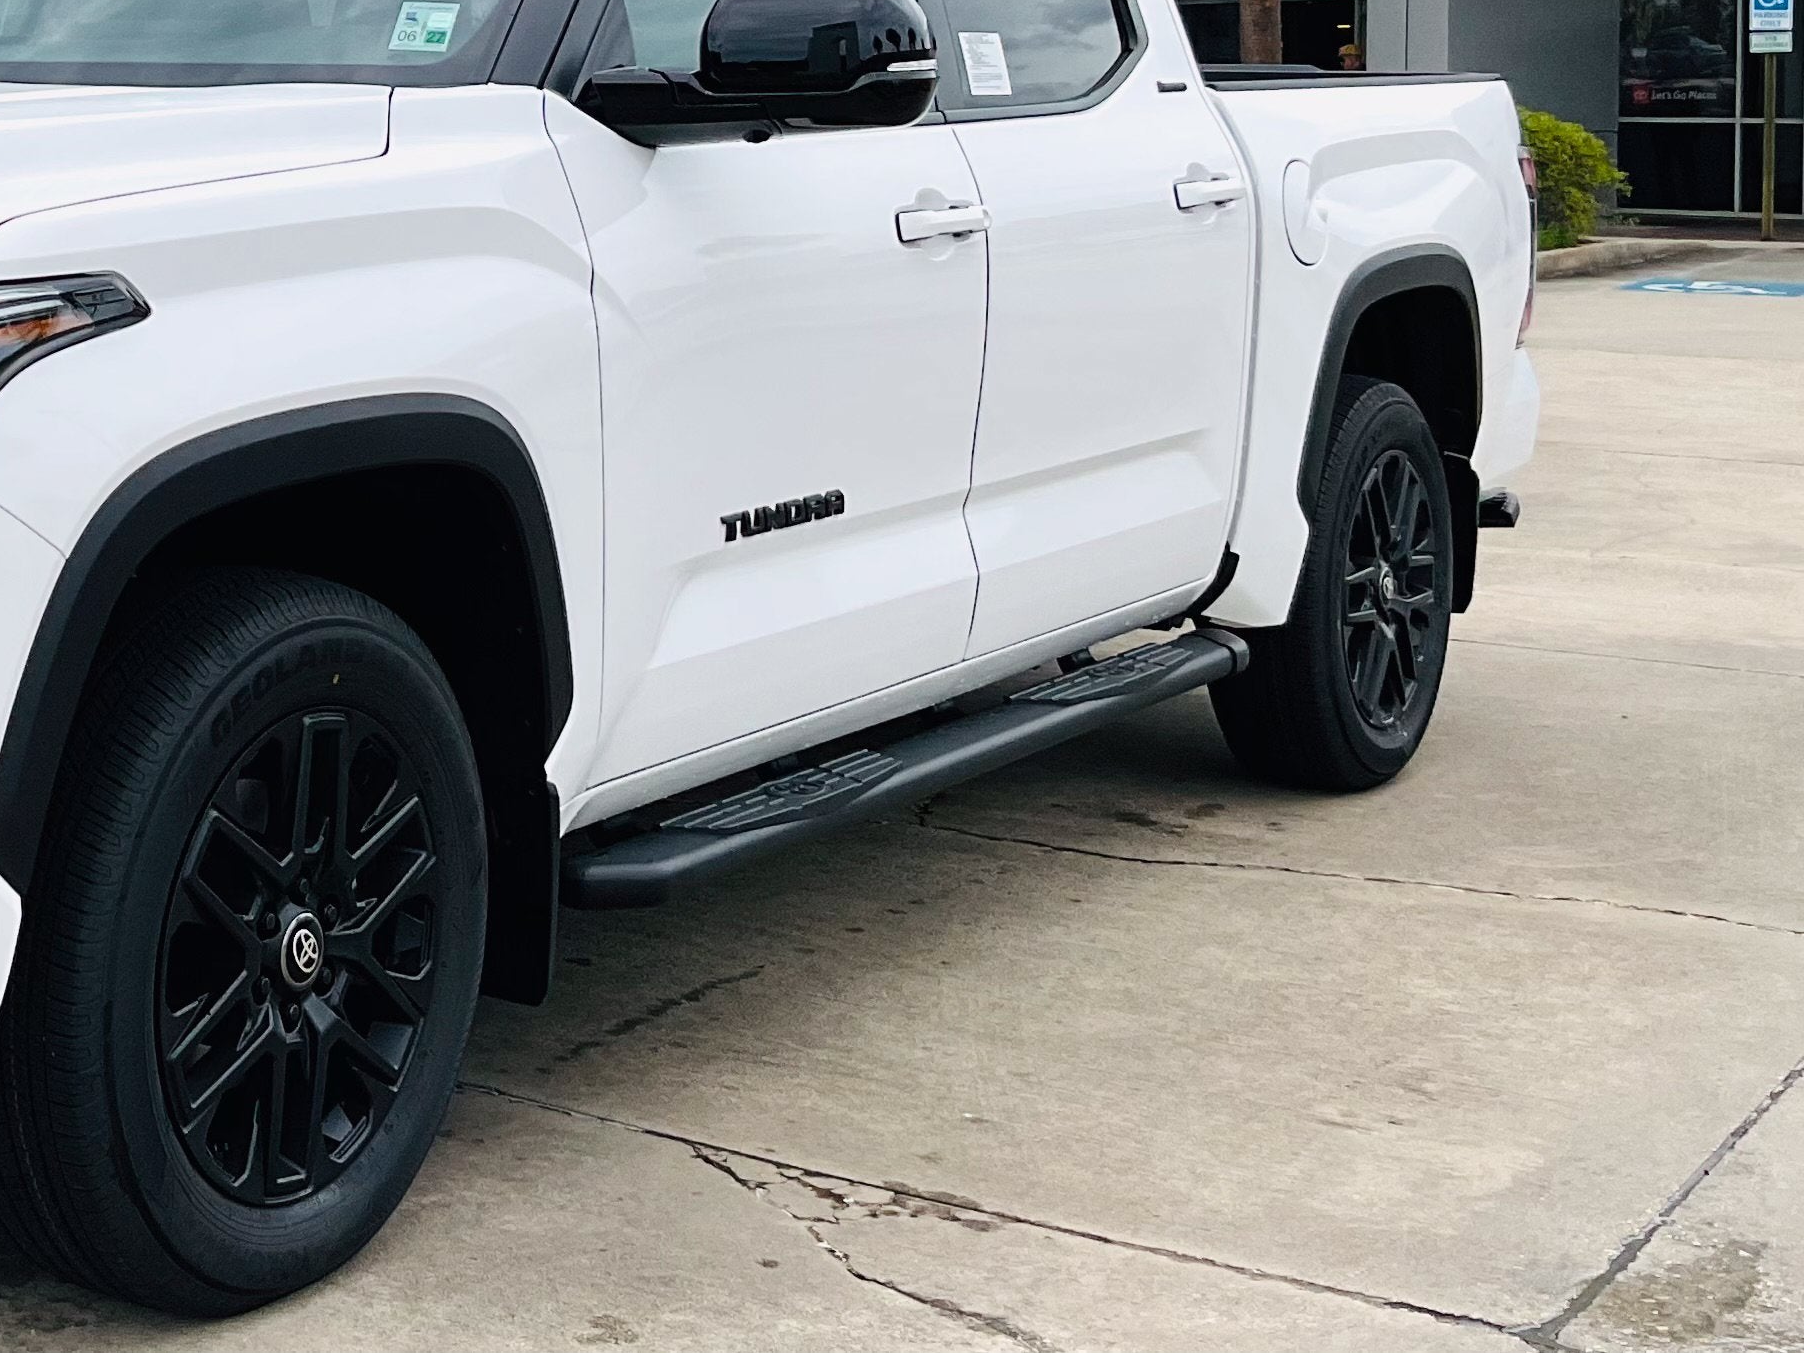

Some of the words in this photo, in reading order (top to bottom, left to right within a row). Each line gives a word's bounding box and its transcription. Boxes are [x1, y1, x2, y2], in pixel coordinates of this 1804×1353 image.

[397, 30, 417, 42] 06
[426, 31, 446, 44] 27
[720, 489, 845, 542] TUNDRA
